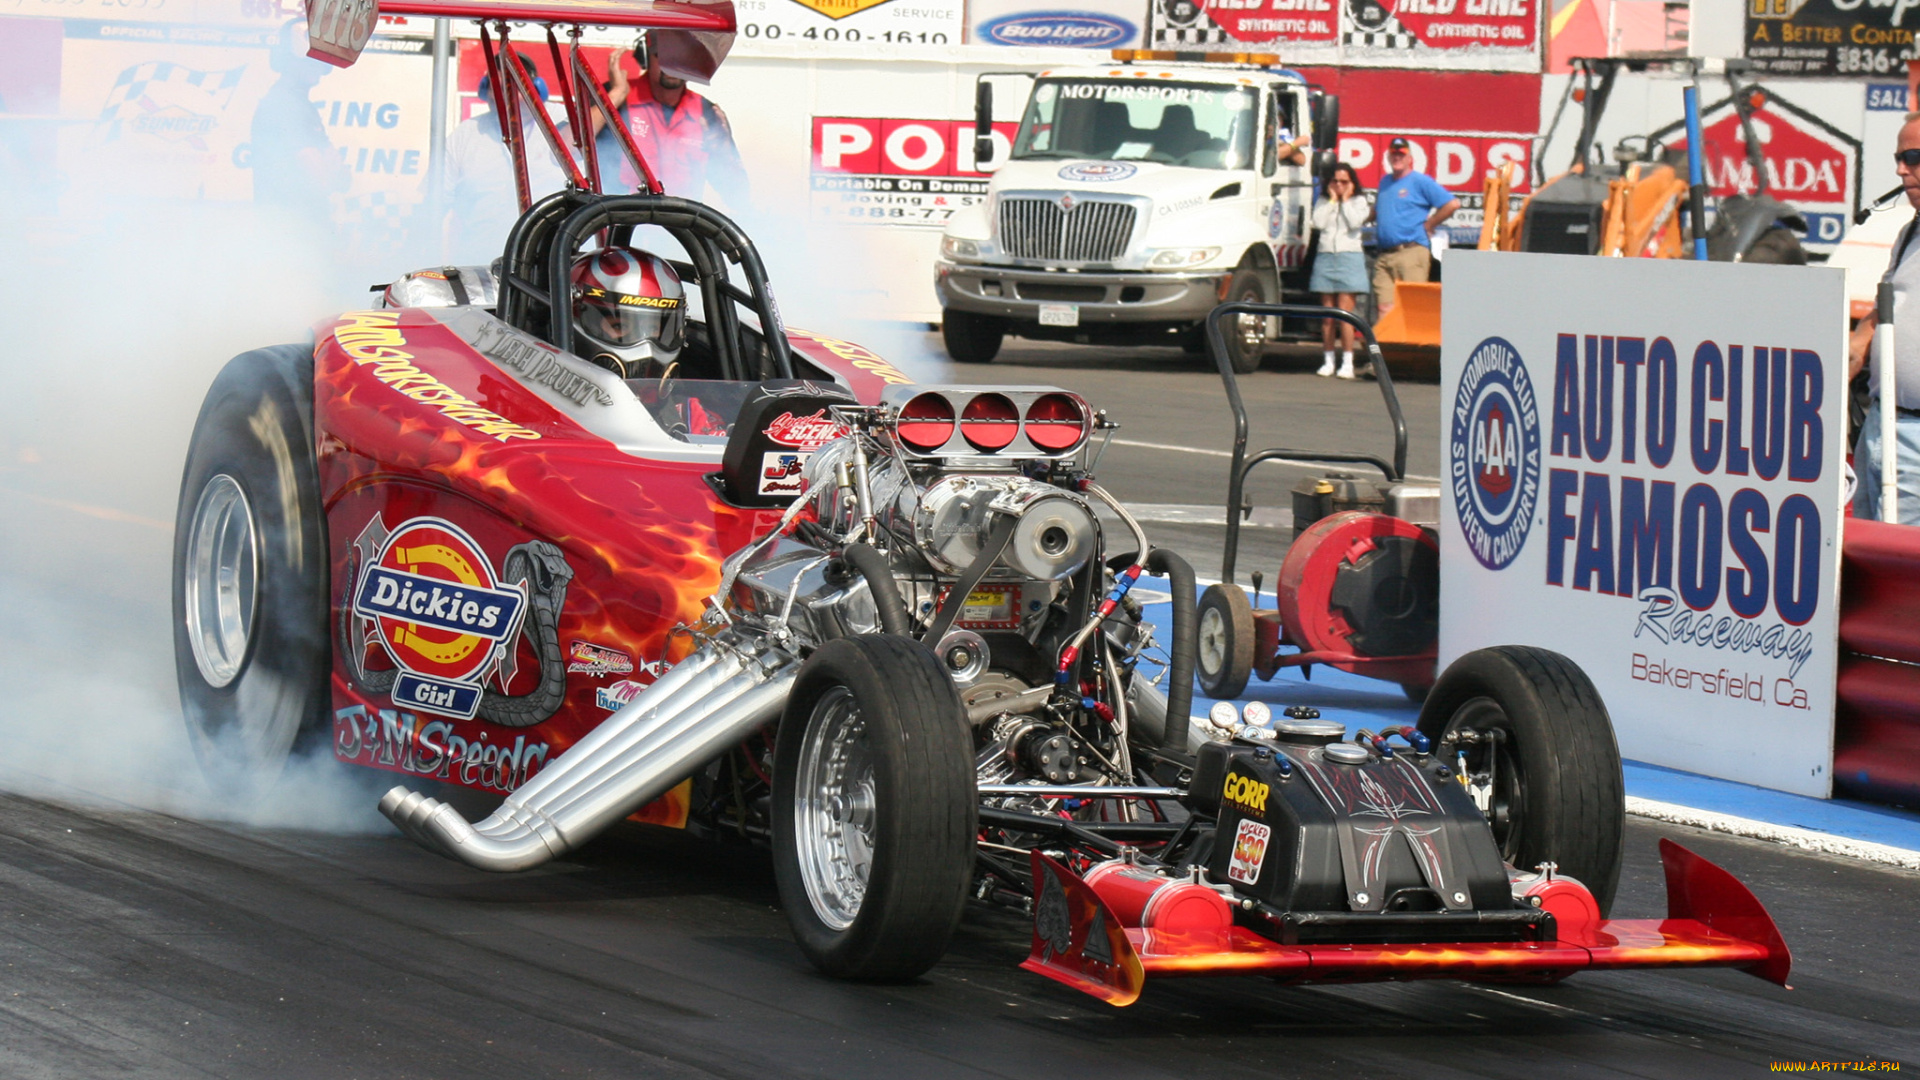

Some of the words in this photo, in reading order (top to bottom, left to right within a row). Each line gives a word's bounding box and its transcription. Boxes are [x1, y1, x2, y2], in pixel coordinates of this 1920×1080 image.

[736, 1, 766, 10] RTS
[892, 8, 955, 20] SERVICE
[100, 26, 164, 38] OFFICIAL
[736, 23, 949, 44] 00-400-1610
[1000, 25, 1053, 38] BUD
[1053, 26, 1116, 38] LIGHT
[1237, 18, 1306, 33] SYNTHETIC
[1308, 20, 1330, 34] OIL
[1426, 23, 1499, 38] SYNTHETIC
[1501, 25, 1526, 39] OIL
[1753, 23, 1770, 42] A
[1781, 22, 1842, 43] BETTER
[1850, 23, 1915, 44] CONTA
[365, 40, 425, 52] ACEWAY
[1060, 84, 1215, 104] MOTORSPORTS
[1868, 89, 1909, 109] SAL
[138, 116, 213, 132] SUNOCO
[821, 123, 1012, 173] POD
[1338, 138, 1526, 189] PODS
[815, 176, 892, 191] Portable
[898, 179, 923, 191] On
[1704, 156, 1840, 194] AMADA
[841, 193, 923, 206] Moving
[934, 197, 948, 206] &
[1456, 343, 1514, 428] AUTOMOBILE
[1512, 364, 1537, 431] CLUB
[1550, 332, 1678, 469] AUTO
[1690, 339, 1824, 483] CLUB
[762, 408, 826, 437] Speed
[784, 424, 838, 440] SCENE
[1475, 418, 1517, 477] AAA
[1453, 441, 1491, 562] SOUTHERN
[1493, 448, 1539, 565] CALIFORNIA
[1546, 467, 1822, 626] FAMOSO
[370, 576, 501, 629] Dickies
[1634, 585, 1813, 679] Raceway
[1631, 652, 1767, 708] Bakersfield,
[1774, 678, 1812, 711] Ca.
[415, 683, 456, 709] Girl
[1224, 772, 1270, 812] GORR
[1241, 822, 1269, 838] WICKED
[1234, 833, 1265, 866] 330
